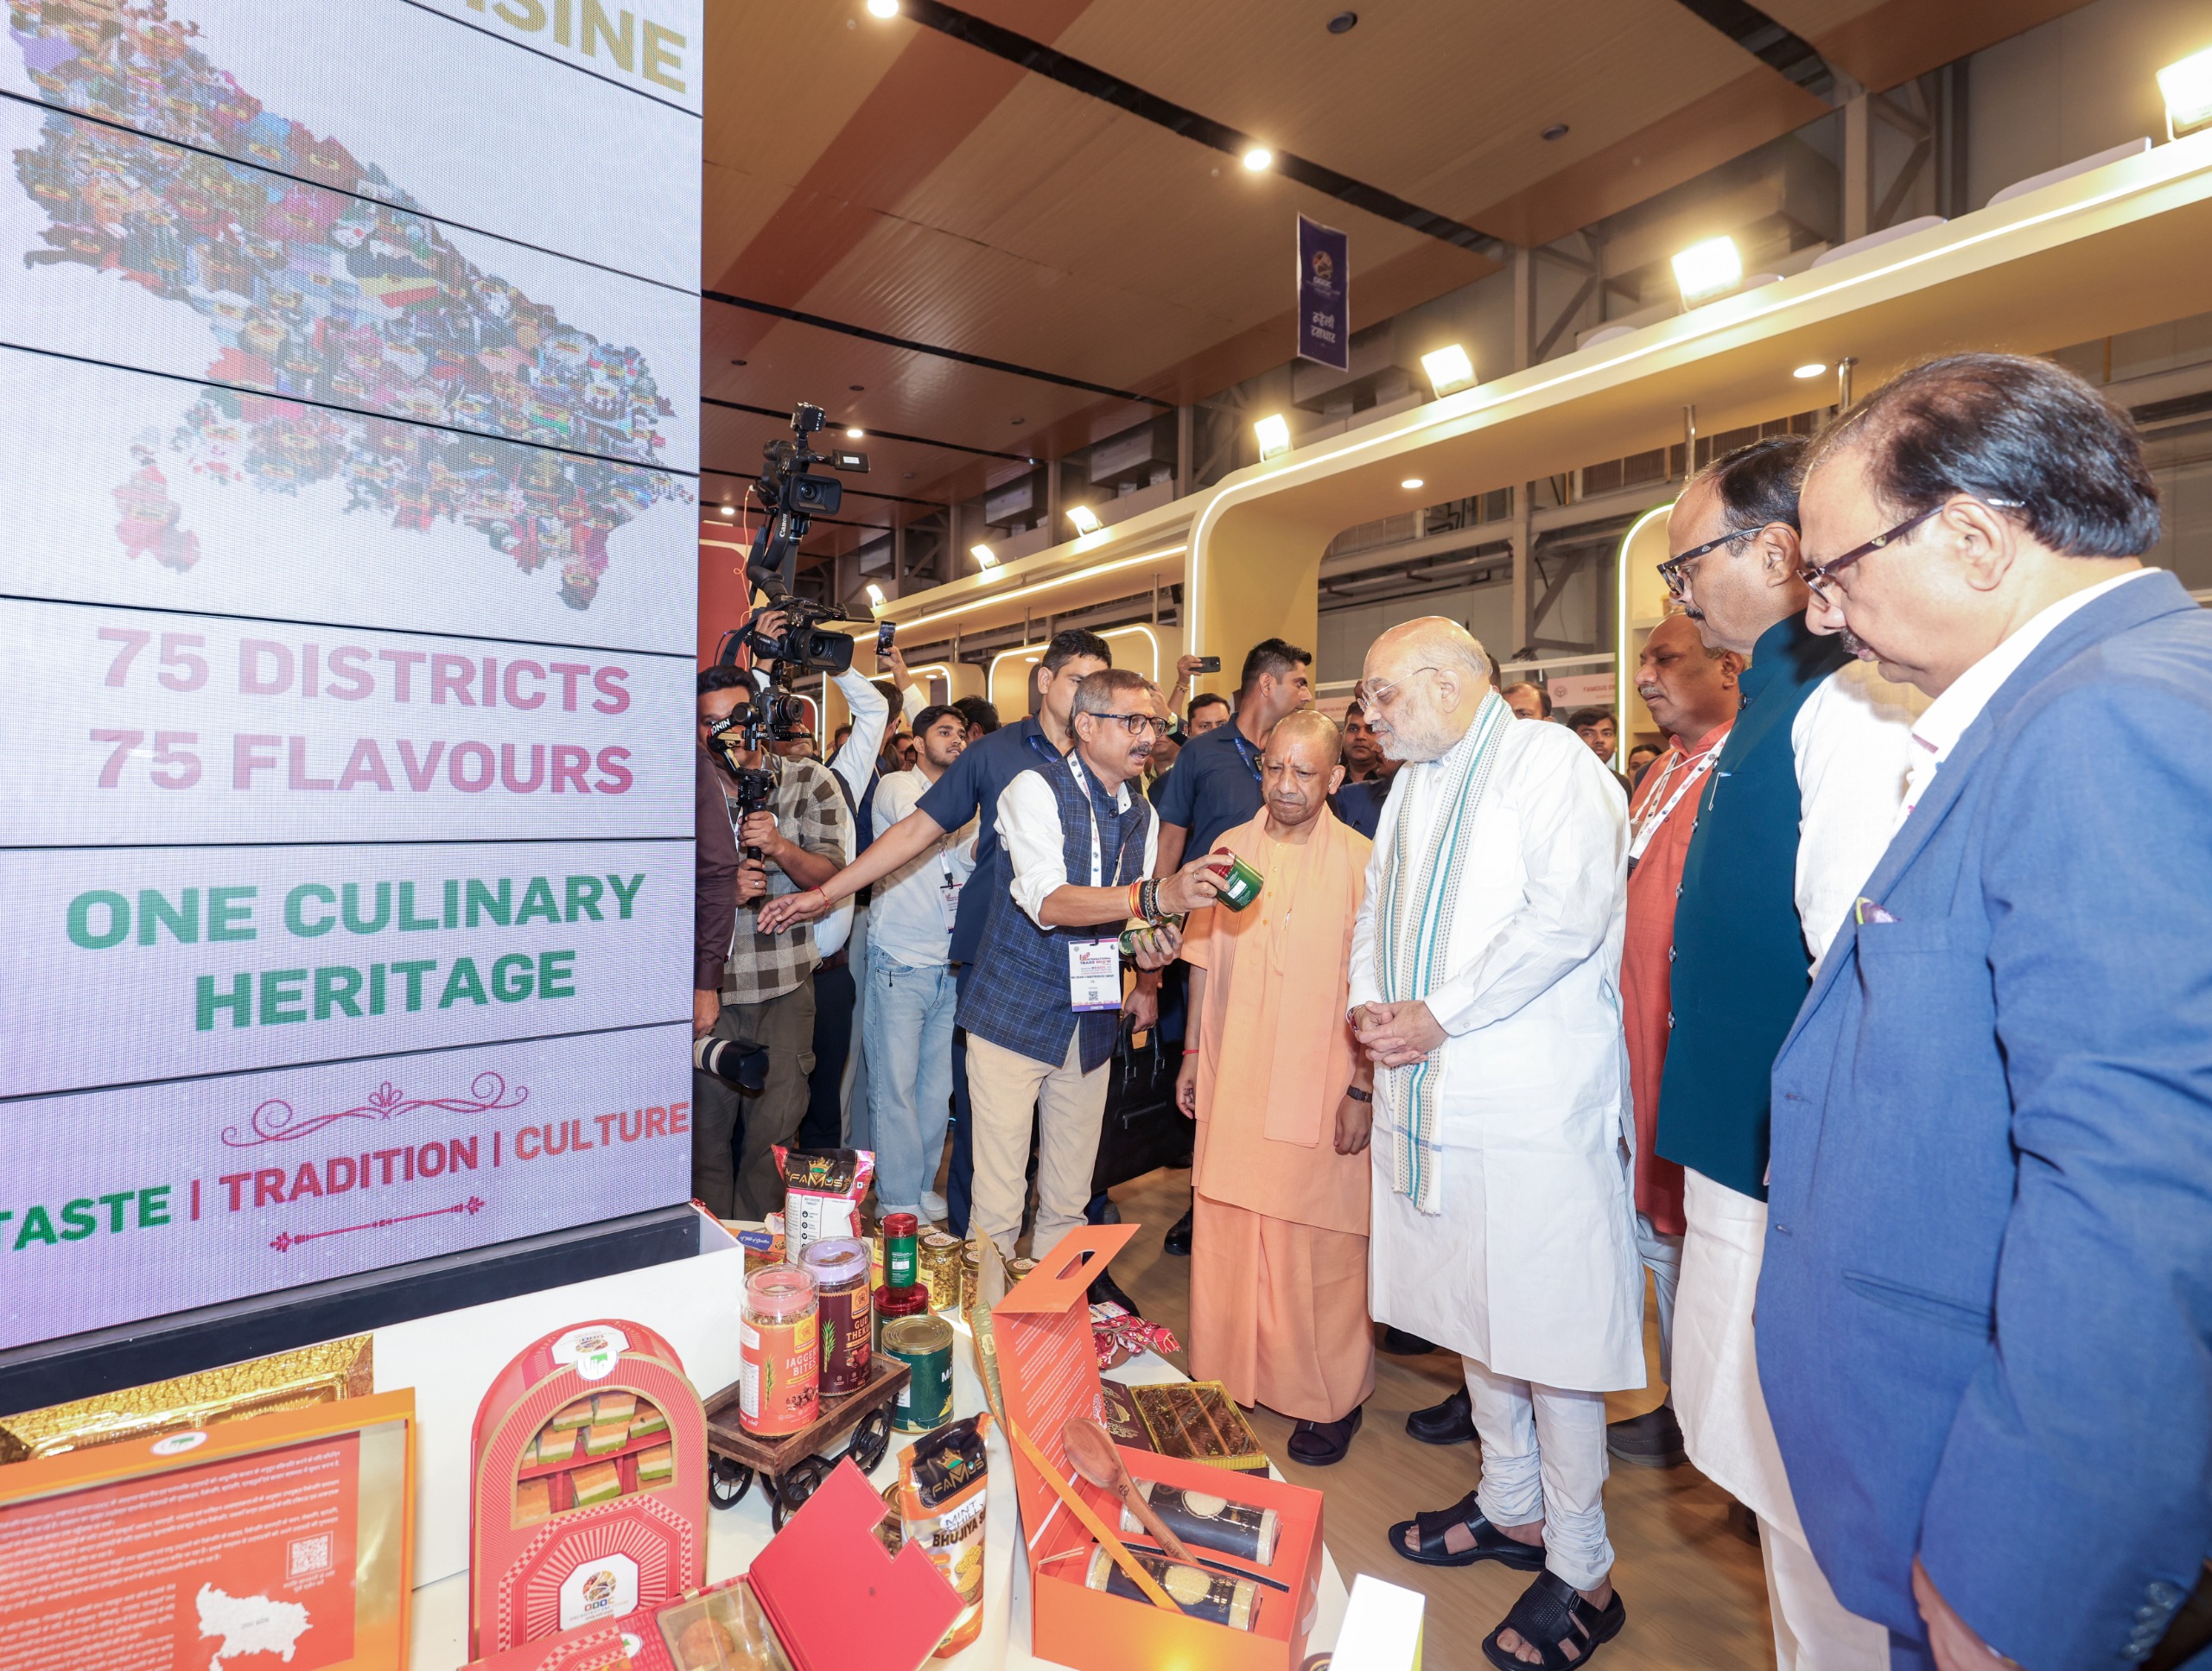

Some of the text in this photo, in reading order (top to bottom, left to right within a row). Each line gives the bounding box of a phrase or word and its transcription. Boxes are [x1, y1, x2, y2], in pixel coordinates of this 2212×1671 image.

[779, 513, 787, 538] Canon
[97, 627, 632, 715] 75 DISTRICTS
[89, 728, 634, 795] 75 FLAVOURS
[66, 873, 646, 950] ONE CULINARY
[195, 950, 576, 1032] HERITAGE
[219, 1134, 479, 1212] TRADITION
[515, 1101, 690, 1161] CULTURE
[854, 1315, 868, 1330] GUD
[792, 1358, 817, 1377] BITES
[945, 1499, 976, 1527] MINT
[931, 1519, 978, 1547] BHUJIYA
[584, 1597, 615, 1612] ODOC
